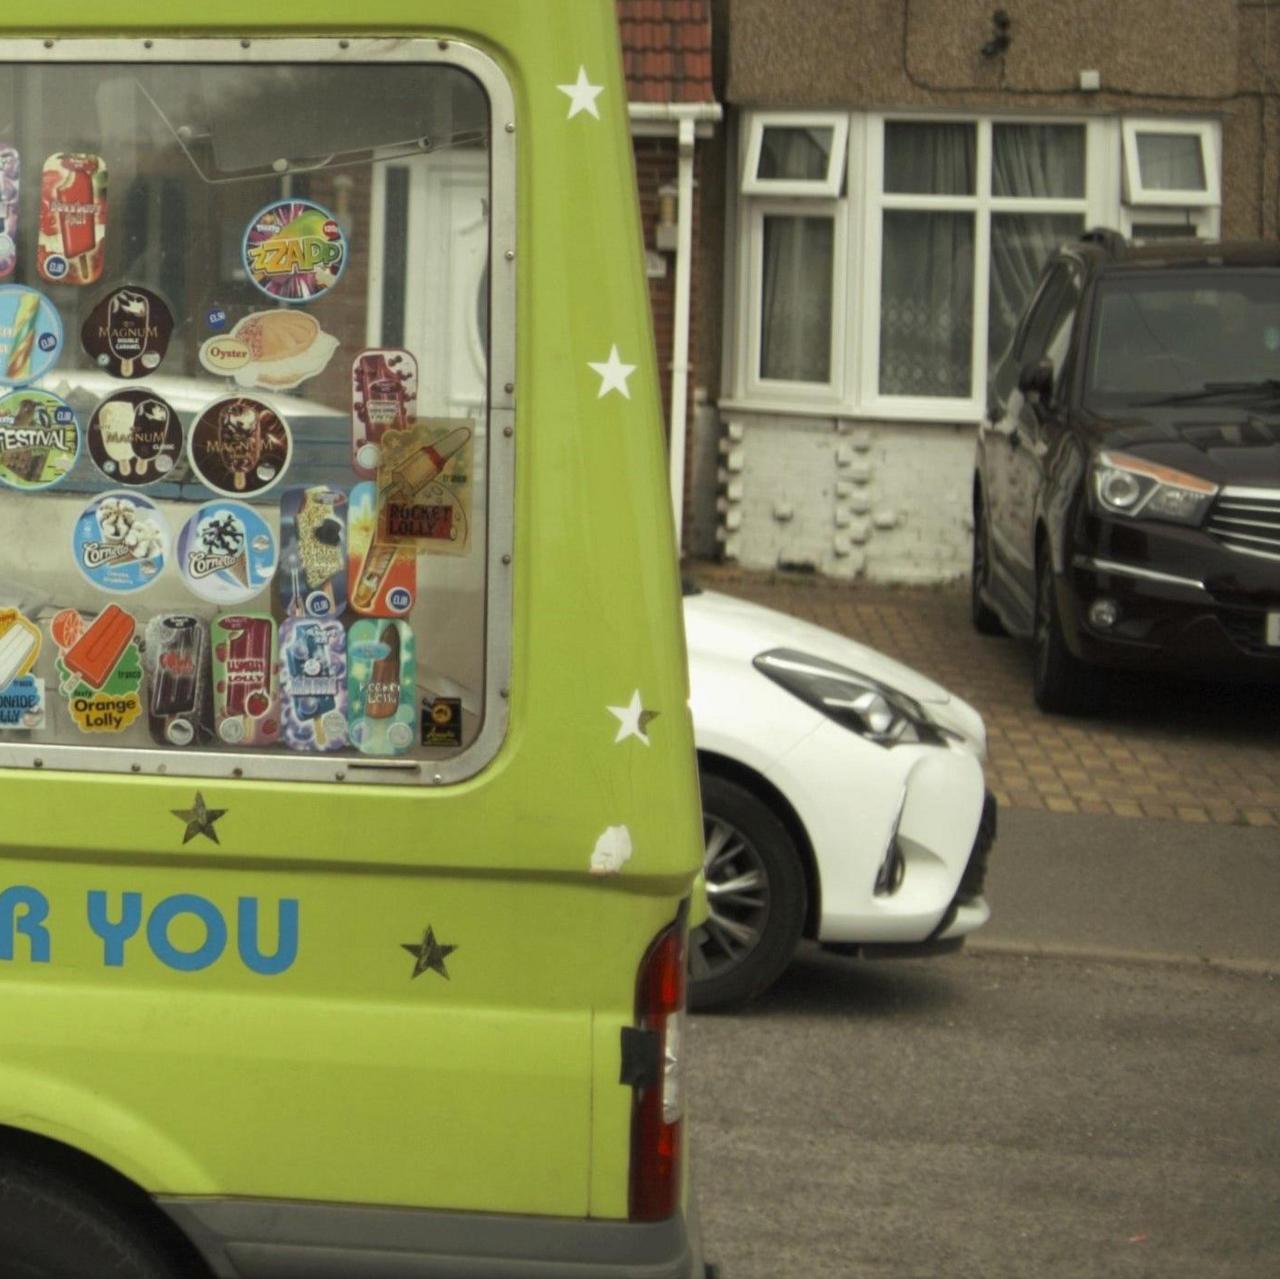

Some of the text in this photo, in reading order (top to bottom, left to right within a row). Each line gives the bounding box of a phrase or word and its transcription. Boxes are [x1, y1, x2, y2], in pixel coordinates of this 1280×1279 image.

[98, 325, 159, 338] MAGNUM
[209, 346, 248, 360] Oyster
[106, 431, 166, 444] MAGNUM
[390, 503, 450, 520] ROCKET
[388, 520, 437, 536] LOLLY
[74, 699, 136, 713] Orange
[85, 713, 123, 729] Lolly
[86, 889, 300, 976] YOU
